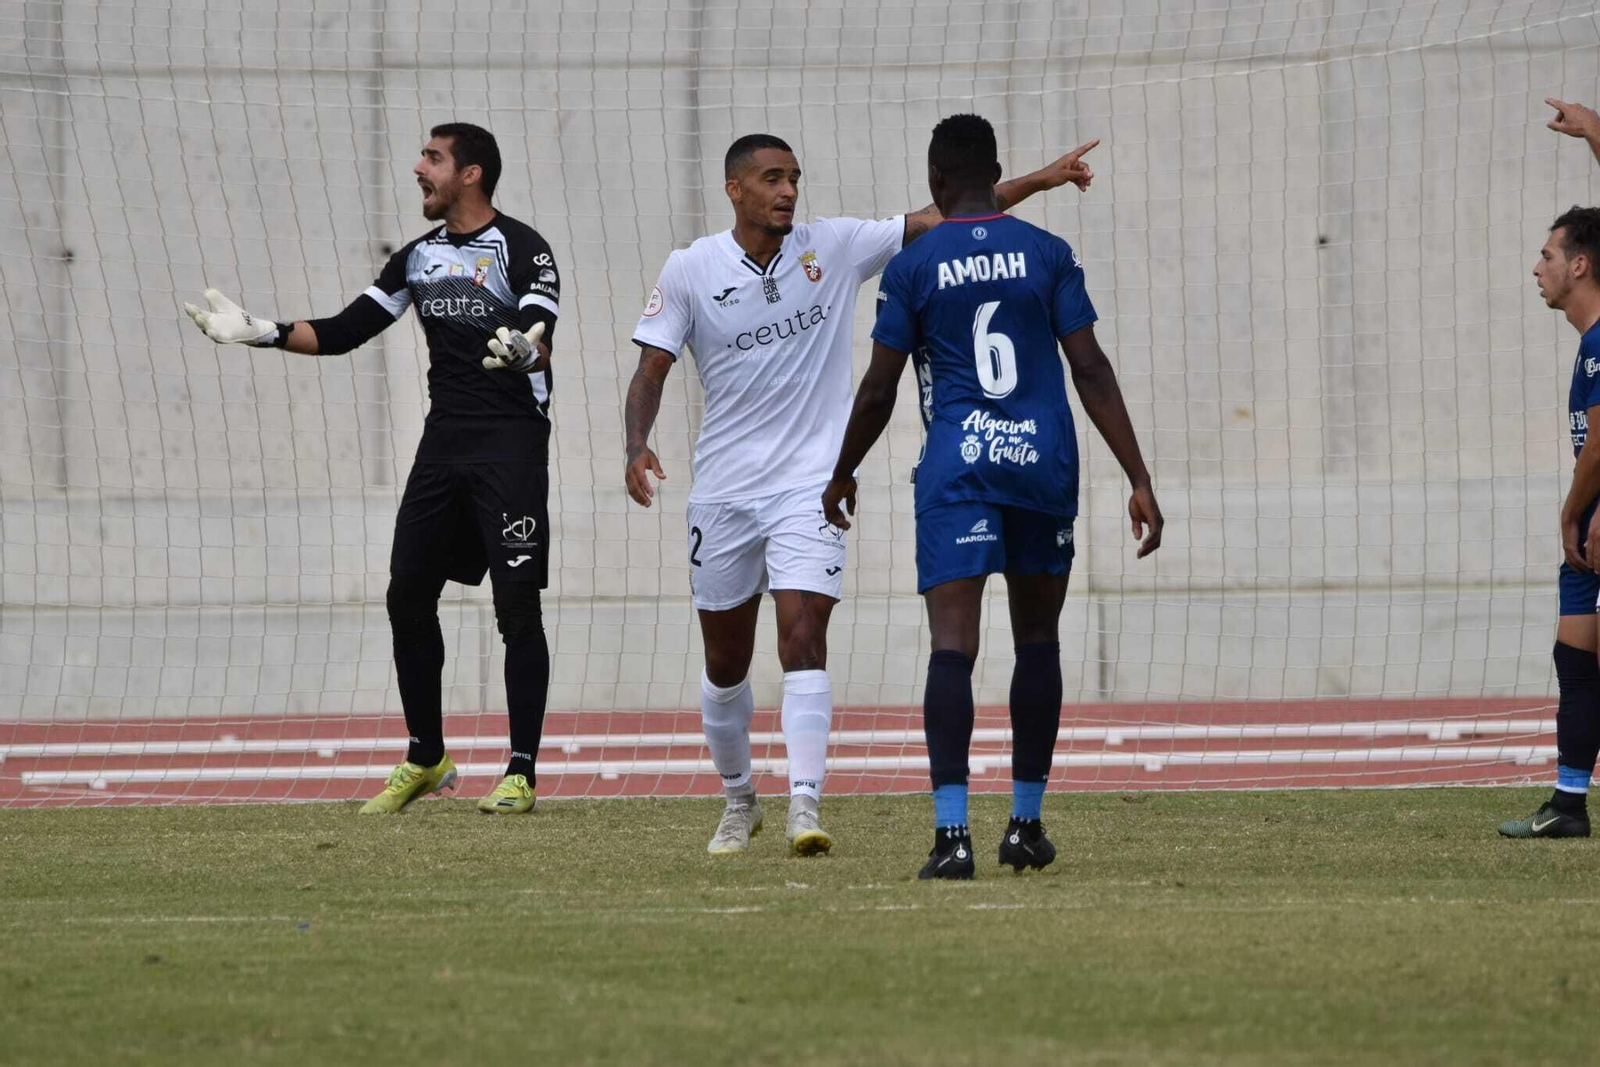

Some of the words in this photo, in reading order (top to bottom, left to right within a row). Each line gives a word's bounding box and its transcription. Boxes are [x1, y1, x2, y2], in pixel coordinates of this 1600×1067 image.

[938, 252, 1027, 290] AMOAH
[972, 300, 1018, 399] 6
[961, 409, 1037, 441] Algeciras
[988, 435, 1040, 466] Gusta
[690, 525, 703, 568] 2
